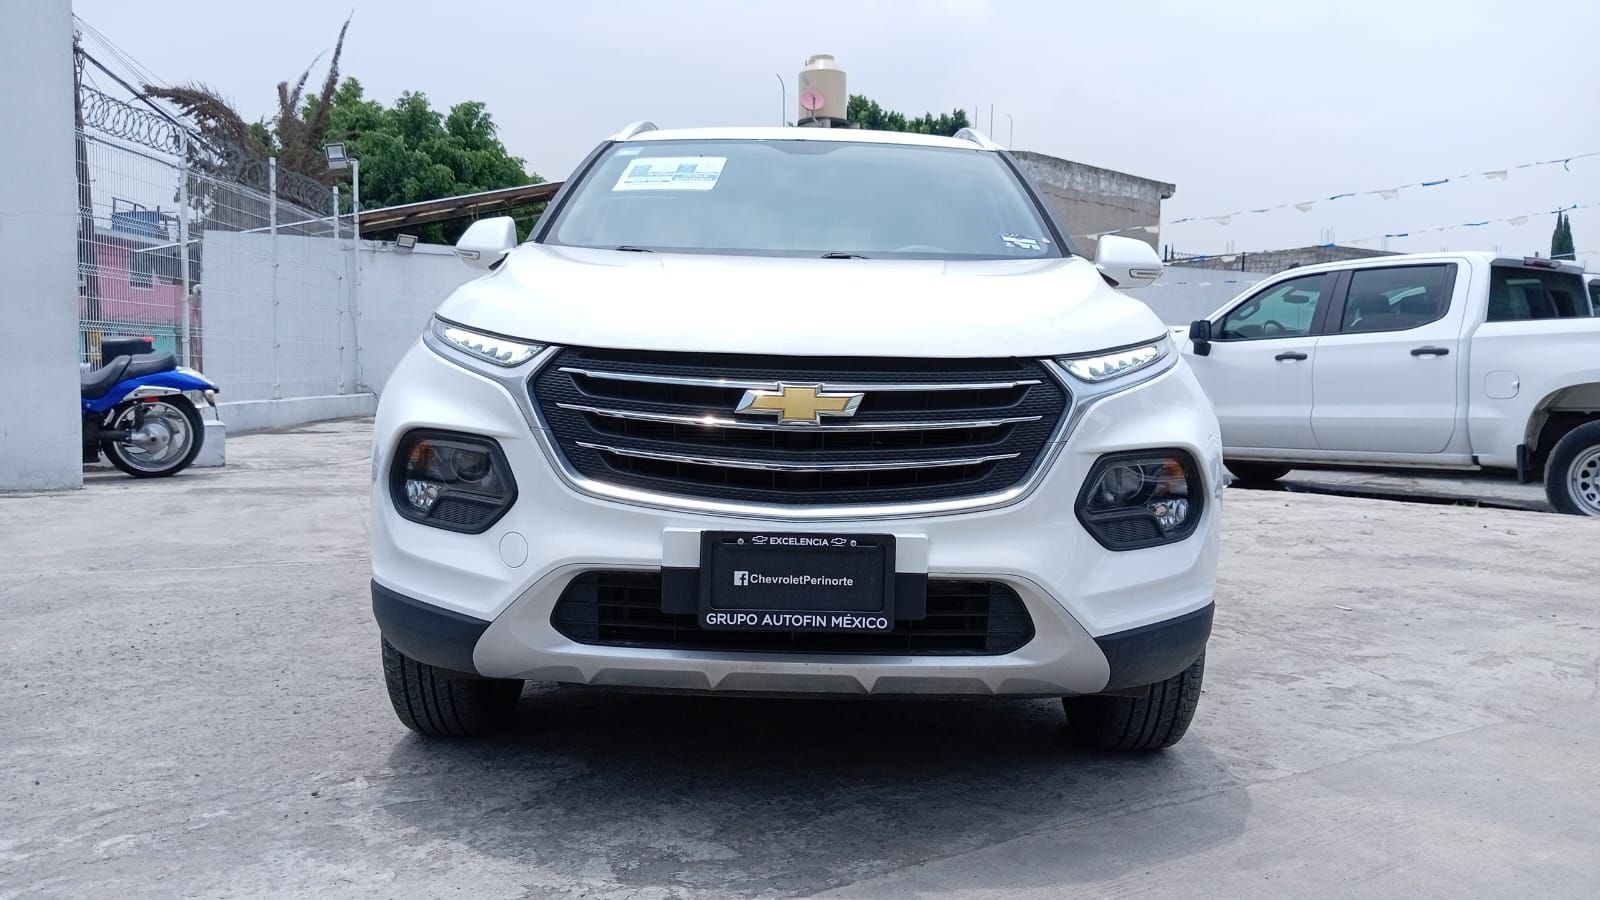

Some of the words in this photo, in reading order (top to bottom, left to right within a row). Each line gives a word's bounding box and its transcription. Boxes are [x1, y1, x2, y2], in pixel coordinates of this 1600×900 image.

[769, 537, 829, 546] EXCELENCIA
[750, 573, 854, 586] ChevroletPerinorte
[706, 613, 758, 626] GRUPO
[761, 614, 827, 628] AUTOFIN
[831, 613, 888, 629] MÉXICO
